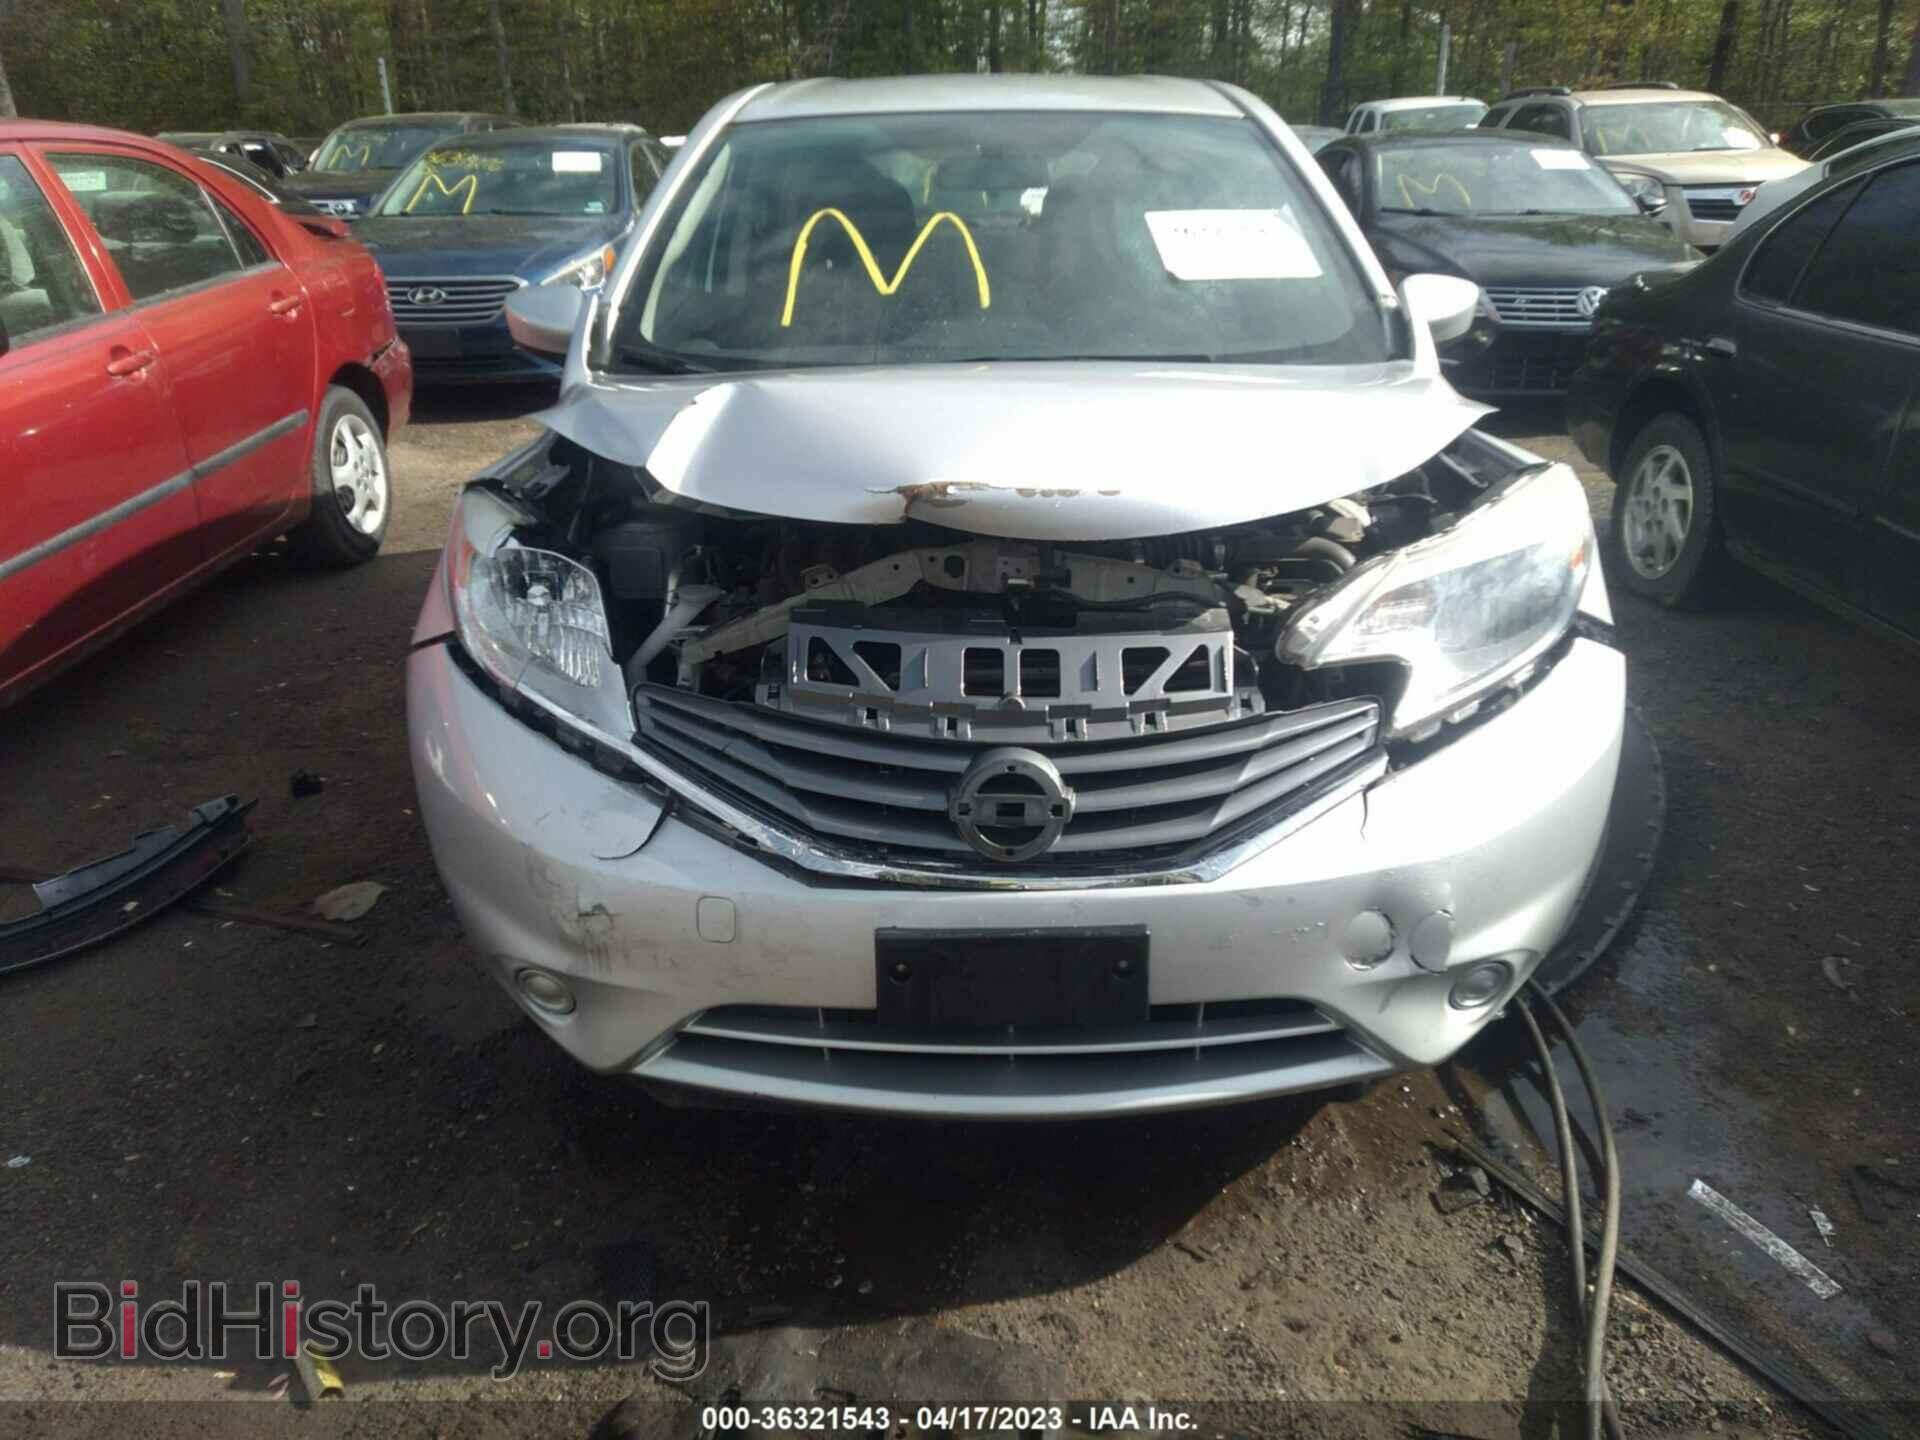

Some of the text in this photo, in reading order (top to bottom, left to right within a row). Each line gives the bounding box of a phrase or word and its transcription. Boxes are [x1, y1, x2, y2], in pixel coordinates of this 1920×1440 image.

[405, 173, 477, 216] M
[1397, 172, 1472, 209] M
[780, 207, 991, 327] M
